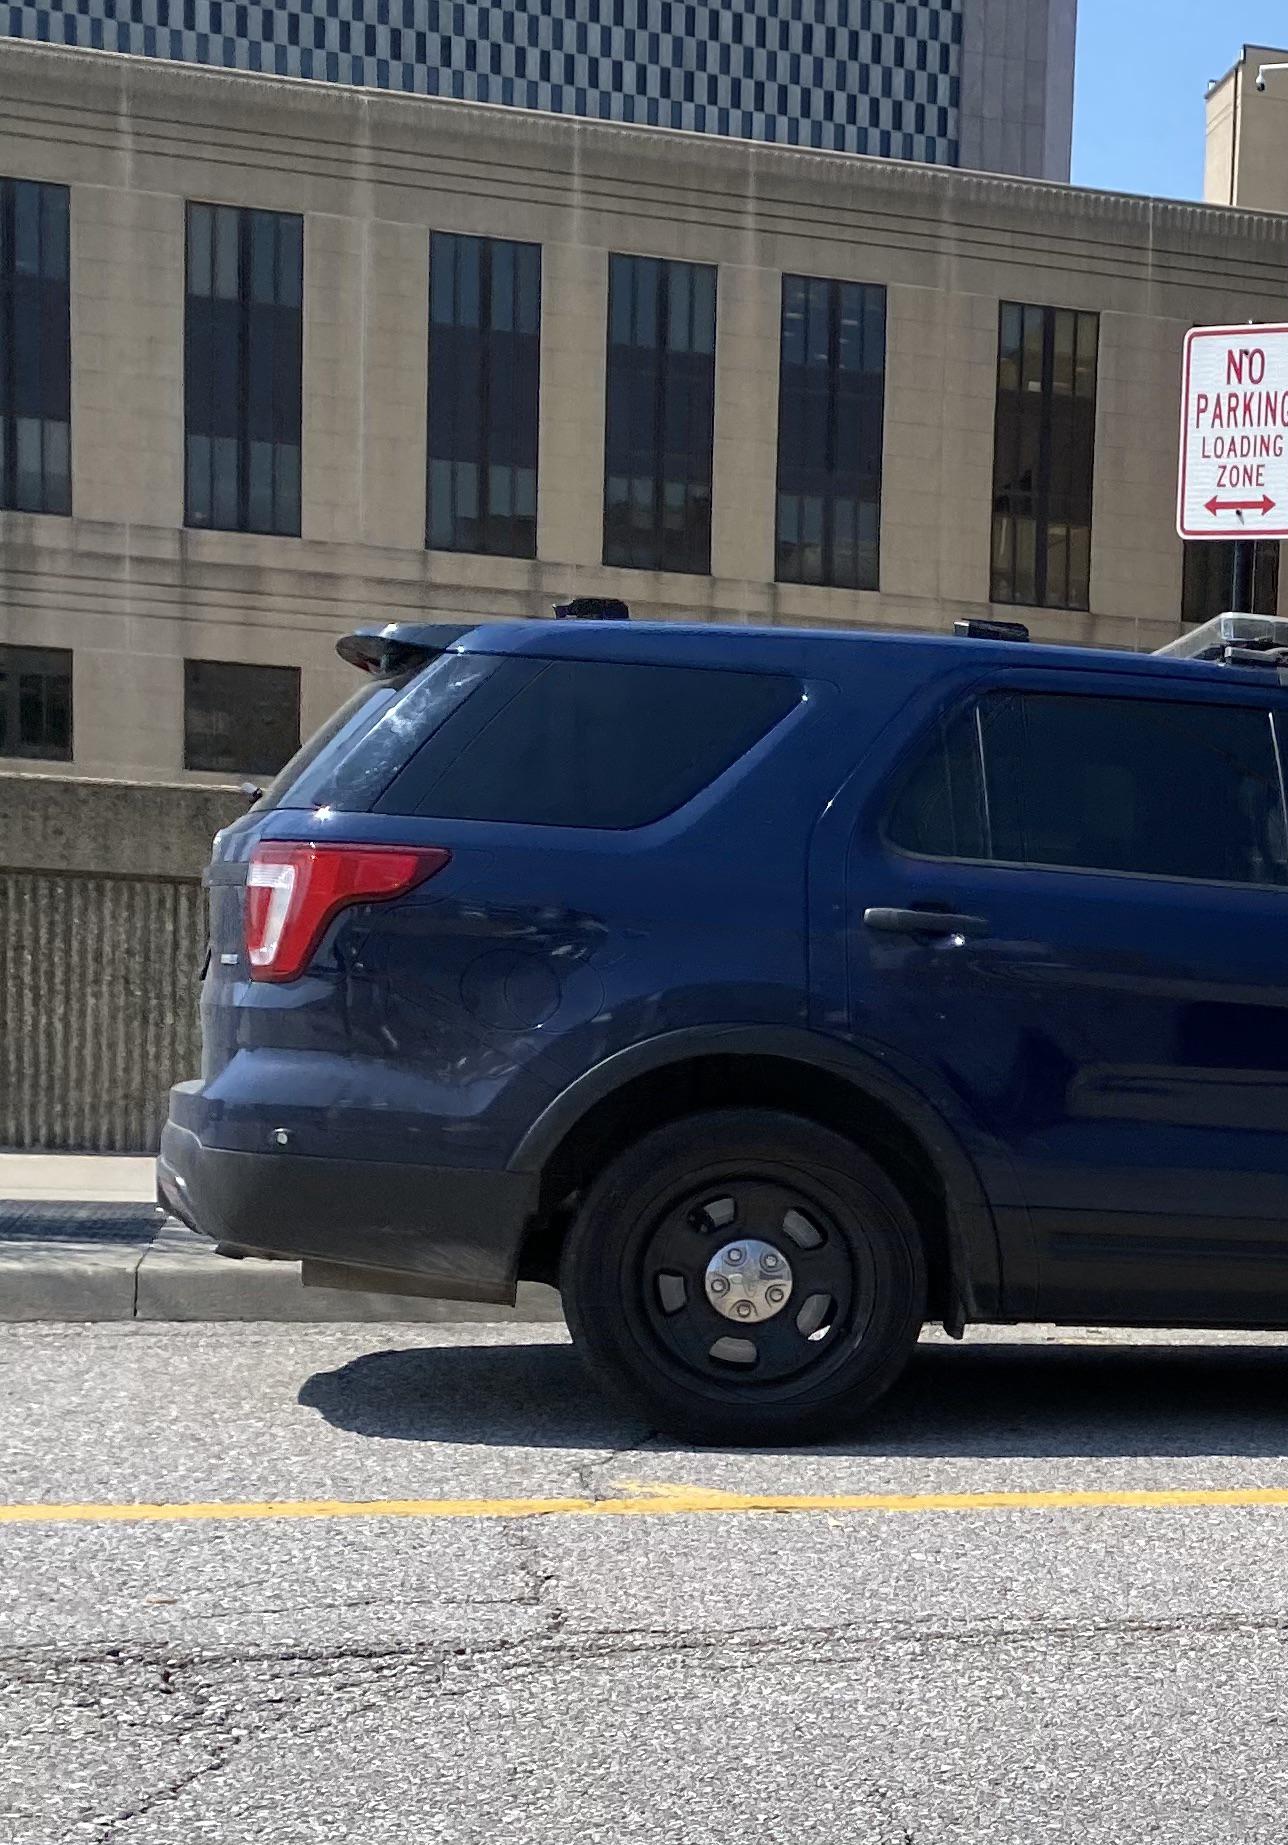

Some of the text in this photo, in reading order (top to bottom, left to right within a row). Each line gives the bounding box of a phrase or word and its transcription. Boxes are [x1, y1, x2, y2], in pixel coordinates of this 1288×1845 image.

[1227, 348, 1265, 384] NO
[1201, 434, 1284, 458] LOADING
[1216, 464, 1266, 488] ZONE
